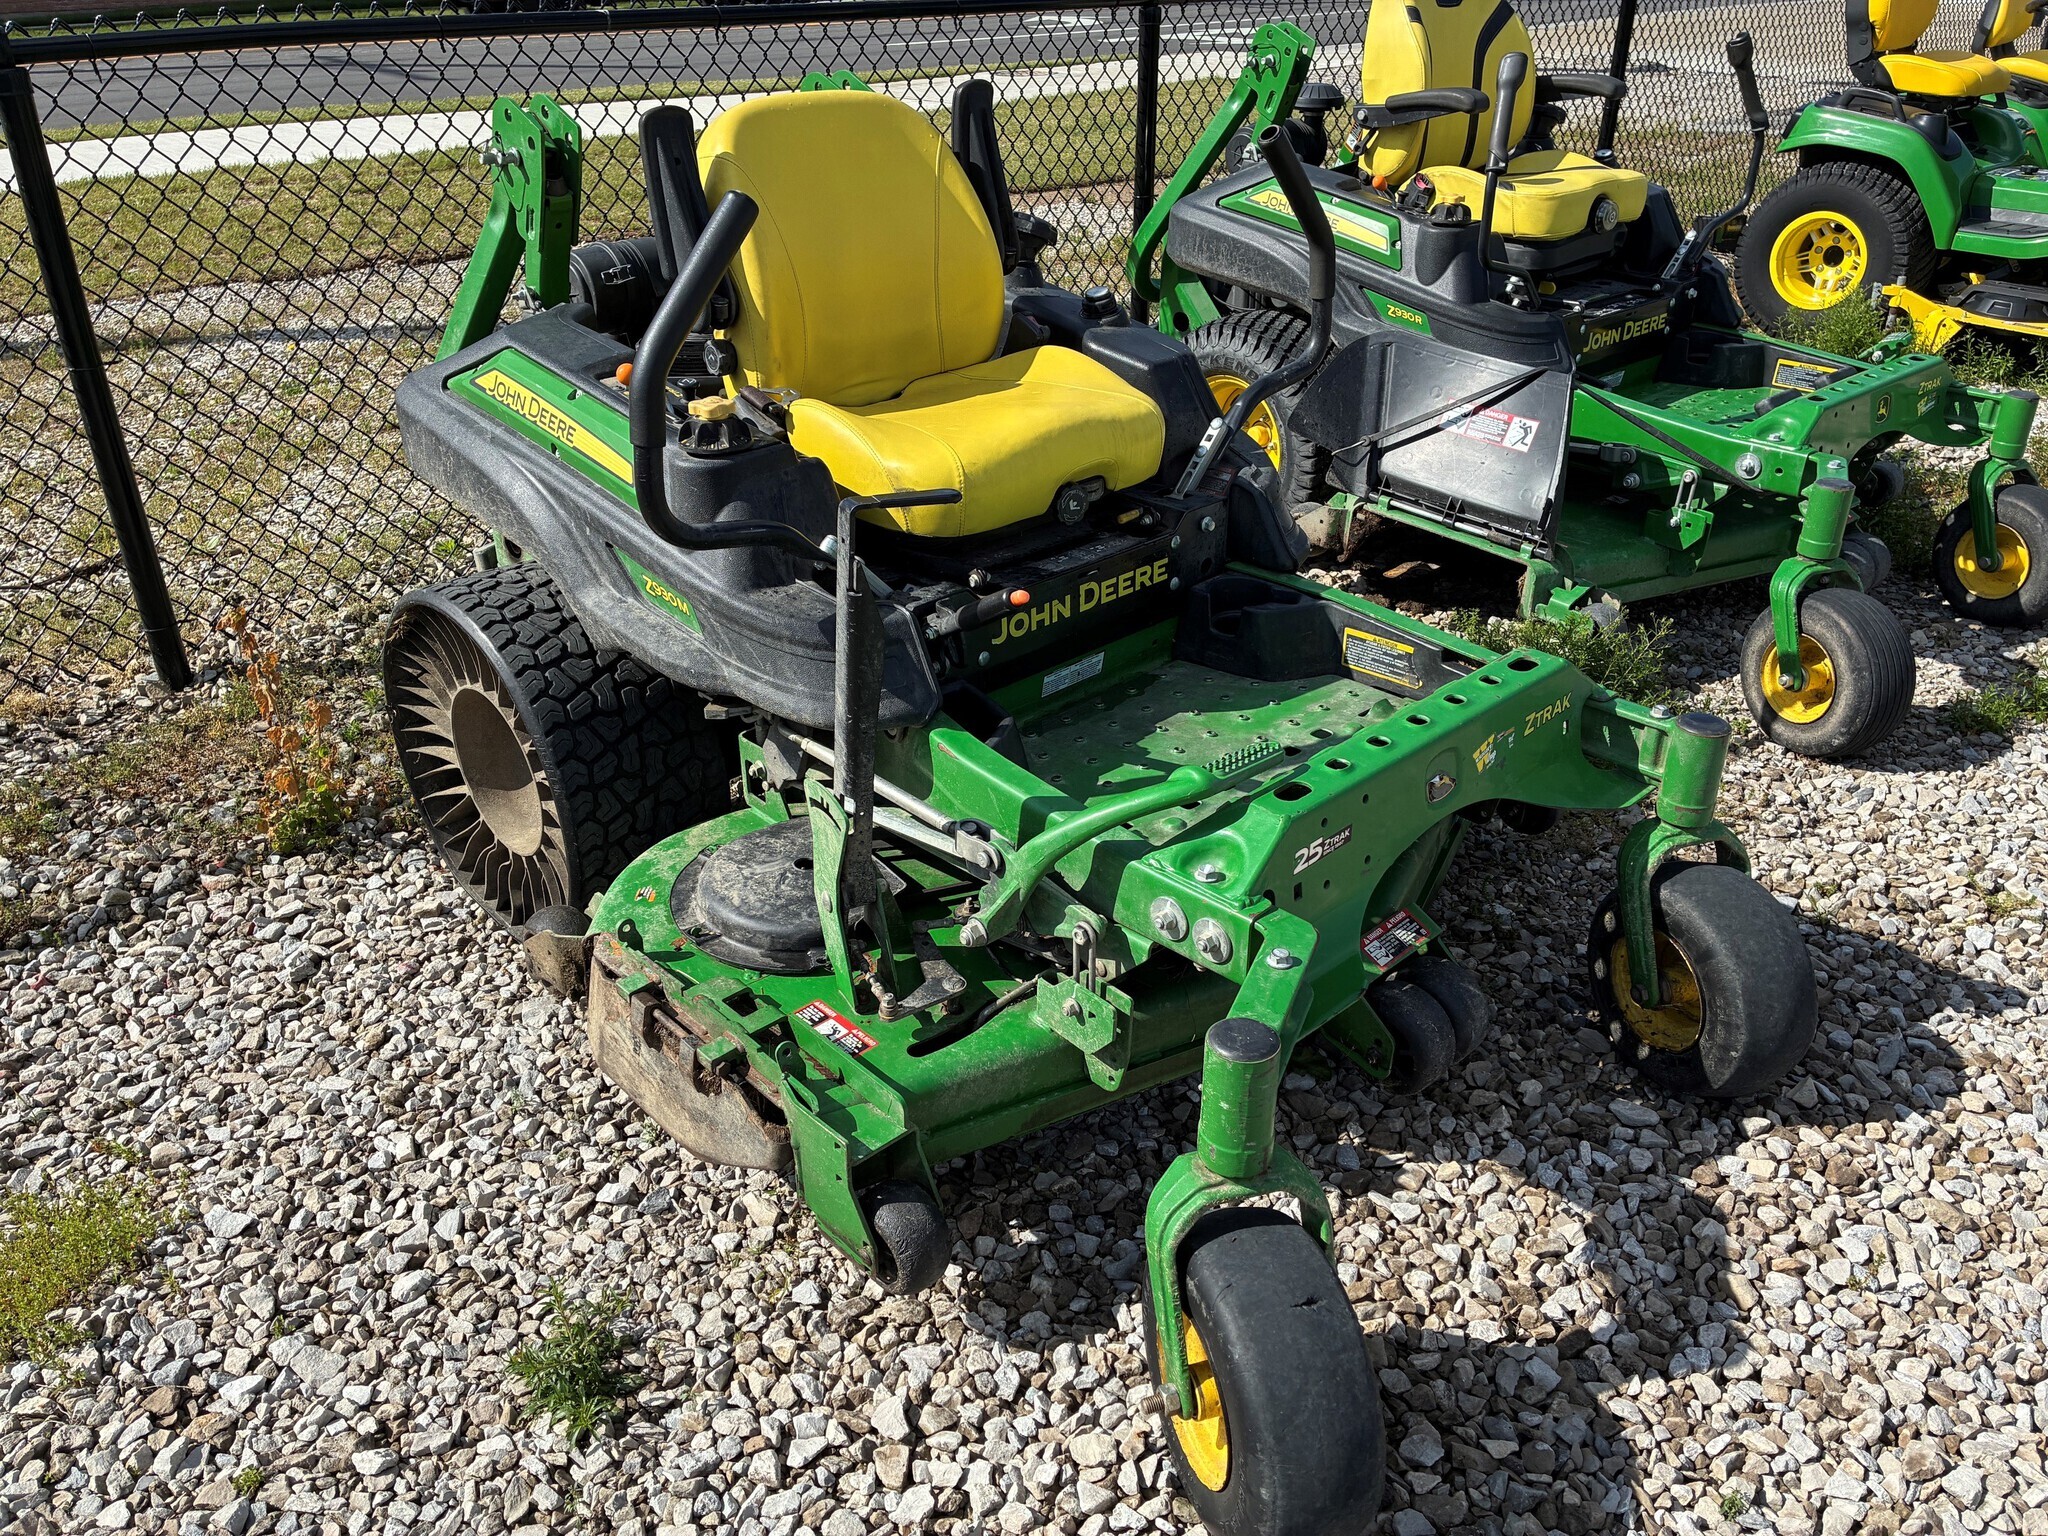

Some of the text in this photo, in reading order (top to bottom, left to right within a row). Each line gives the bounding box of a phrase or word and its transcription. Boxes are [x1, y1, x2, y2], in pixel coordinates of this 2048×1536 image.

[1386, 304, 1423, 325] Z930R
[1583, 313, 1668, 353] JOHN DEERE
[488, 374, 577, 445] JOHN DEERE
[1484, 409, 1509, 421] DANGER
[642, 574, 690, 616] Z930M
[992, 557, 1169, 645] JOHN DEERE
[1523, 692, 1571, 736] ZTRAK
[1293, 828, 1351, 875] 25 ZTRAK
